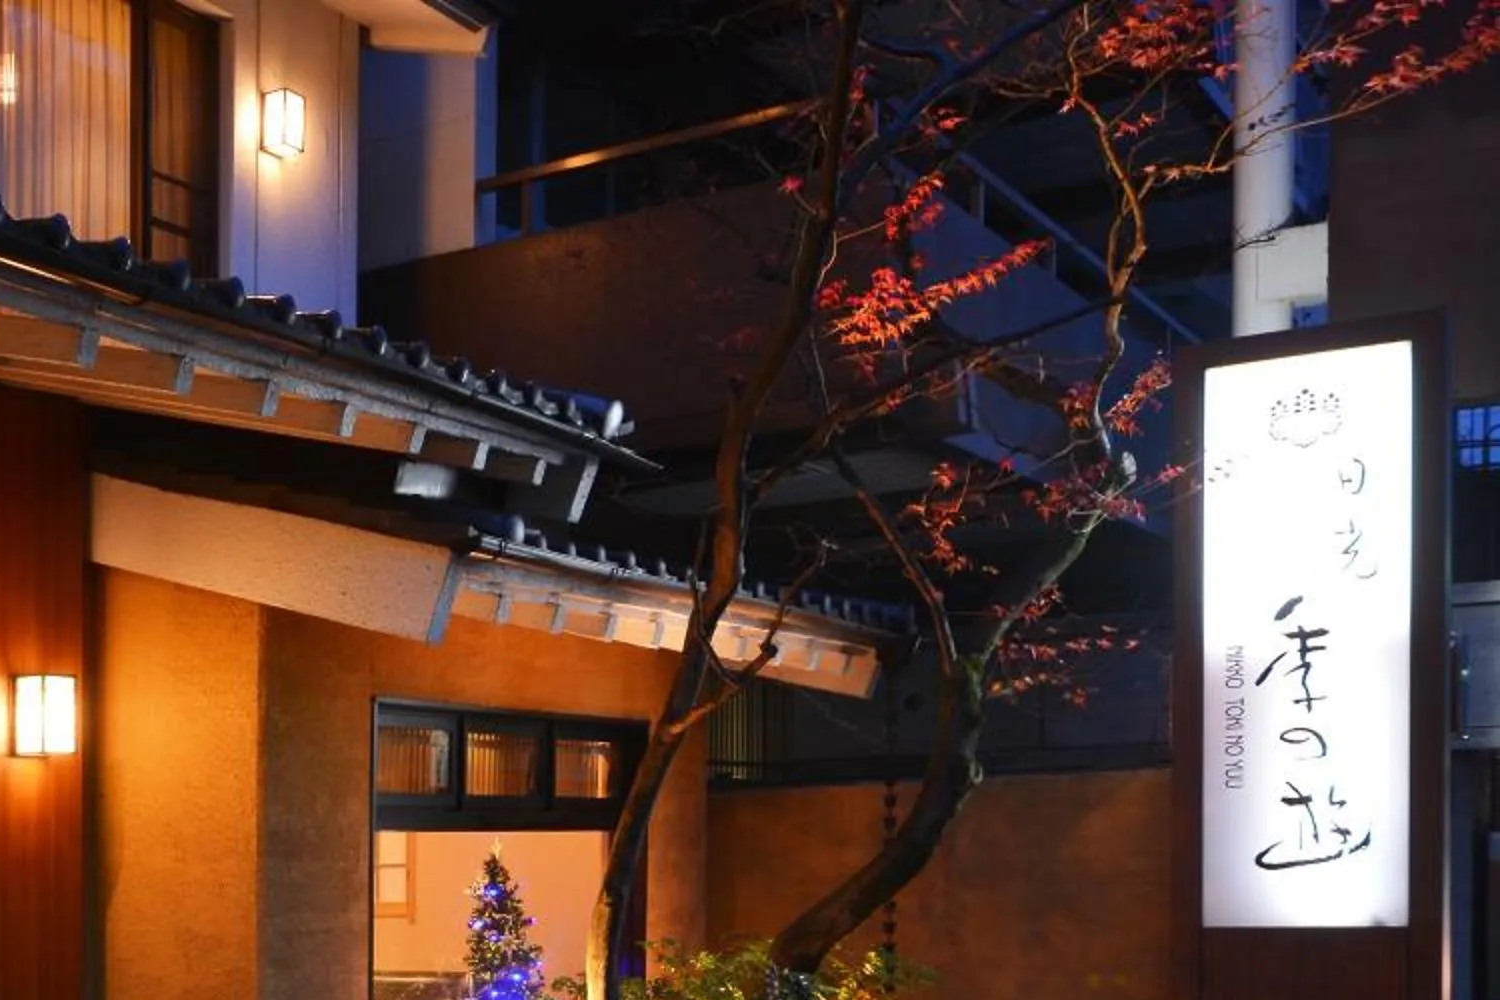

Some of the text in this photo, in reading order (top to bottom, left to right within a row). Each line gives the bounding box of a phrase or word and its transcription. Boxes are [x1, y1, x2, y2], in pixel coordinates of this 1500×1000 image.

[1224, 696, 1245, 732] TOKI
[1224, 735, 1245, 757] NO
[1255, 595, 1372, 871] 季の遊
[1224, 758, 1245, 790] YUU
